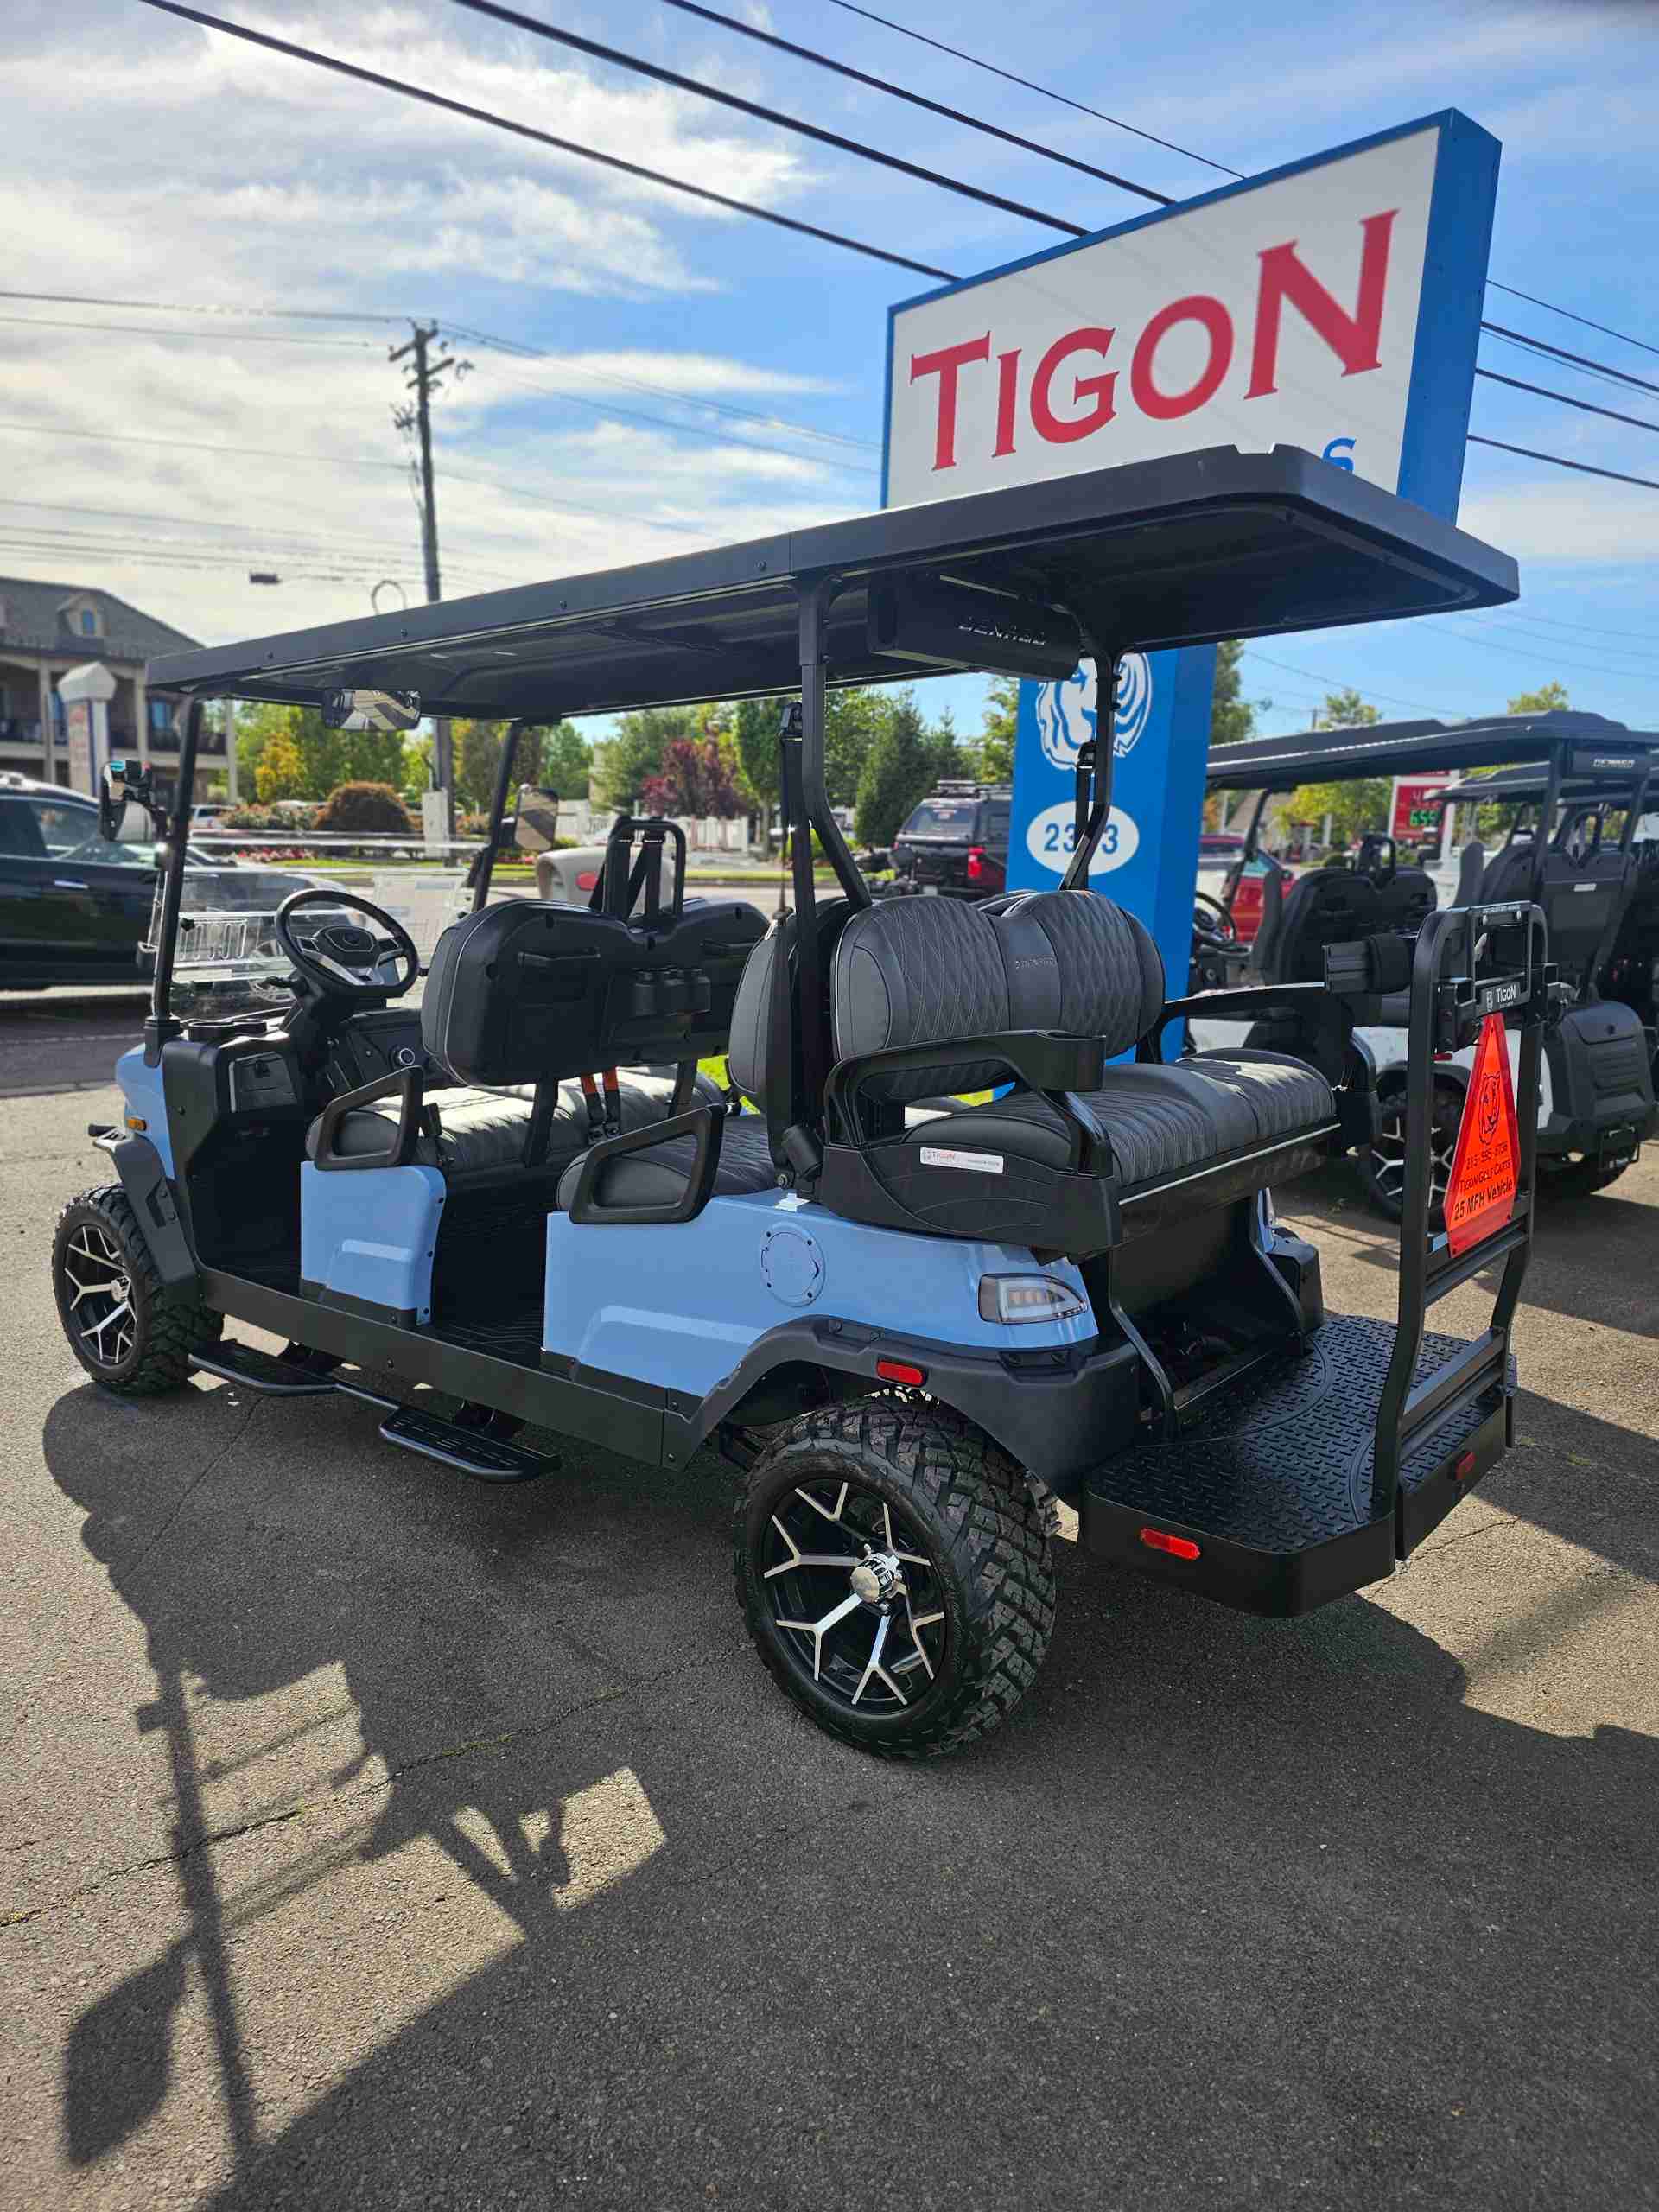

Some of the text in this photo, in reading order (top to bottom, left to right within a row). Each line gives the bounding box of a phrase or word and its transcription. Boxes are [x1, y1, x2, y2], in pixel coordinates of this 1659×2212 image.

[910, 209, 1400, 472] TIGON
[1044, 823, 1119, 855] 233
[1496, 984, 1516, 1003] TIGON
[1453, 1176, 1513, 1221] 25 MPH Vehicle
